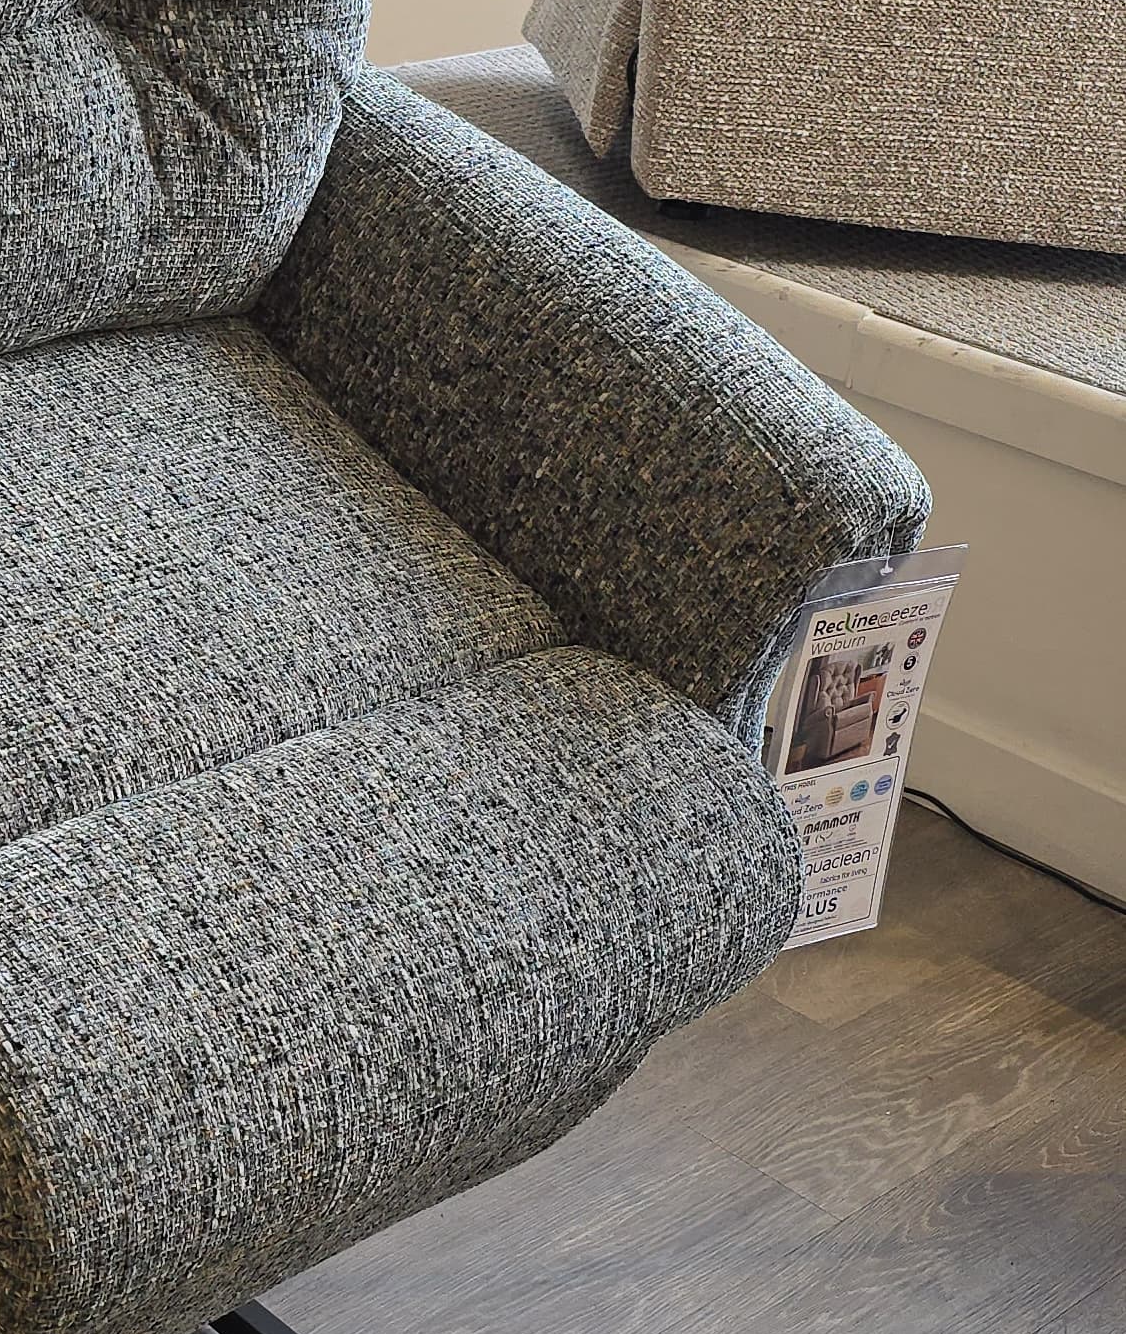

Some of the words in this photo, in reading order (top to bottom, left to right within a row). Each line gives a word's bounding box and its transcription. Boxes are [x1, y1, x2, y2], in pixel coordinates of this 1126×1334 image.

[811, 636, 866, 655] Woburn
[906, 657, 914, 668] 5
[803, 803, 823, 814] Zero
[804, 811, 862, 835] MAMMOTH
[842, 871, 851, 879] for
